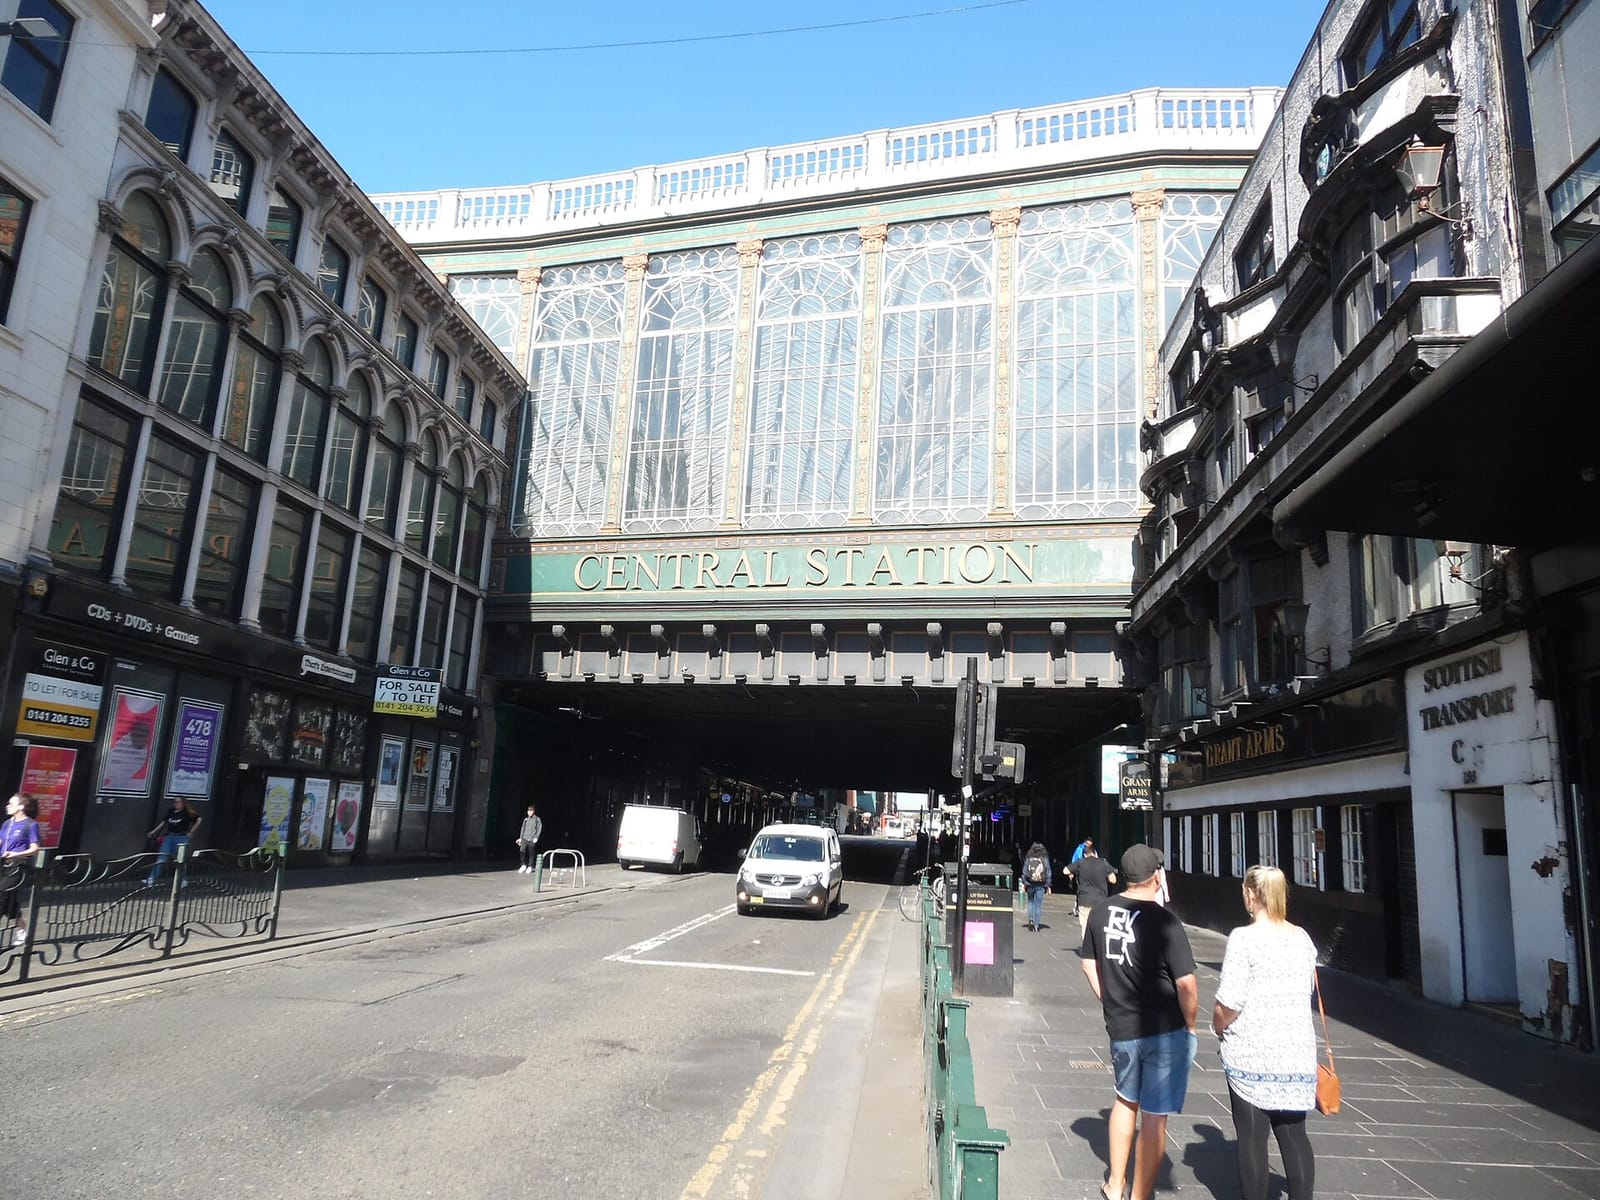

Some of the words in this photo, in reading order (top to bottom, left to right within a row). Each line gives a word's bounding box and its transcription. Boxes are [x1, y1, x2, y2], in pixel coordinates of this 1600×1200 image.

[574, 551, 790, 591] CENTRAL
[805, 544, 1038, 587] STATION
[87, 603, 111, 621] CDs
[114, 612, 122, 623] +
[123, 613, 153, 633] DVDs
[154, 623, 162, 634] +
[164, 625, 200, 645] Games
[44, 648, 69, 666] Glen
[71, 658, 78, 667] &
[80, 656, 95, 671] Co
[389, 666, 409, 675] Glen
[417, 668, 430, 678] Co
[1423, 647, 1502, 693] SCOTTISH
[26, 681, 39, 692] TO
[41, 684, 57, 696] LET
[62, 687, 79, 699] FOR
[80, 690, 100, 703] SALE
[379, 680, 403, 691] FOR
[408, 682, 437, 694] SALE
[380, 691, 386, 700] /
[391, 692, 408, 702] TO
[413, 694, 434, 704] LET
[398, 703, 413, 711] 204
[416, 705, 435, 713] 3255
[1419, 685, 1517, 731] TRANSPORT
[28, 709, 49, 721] 0141
[51, 713, 67, 724] 204
[68, 715, 89, 727] 3255
[185, 718, 212, 736] 478
[183, 735, 209, 747] million
[1206, 736, 1242, 767] GRANT
[1246, 724, 1285, 759] ARMS
[1122, 776, 1153, 787] GRANT
[1127, 788, 1149, 796] ARMS
